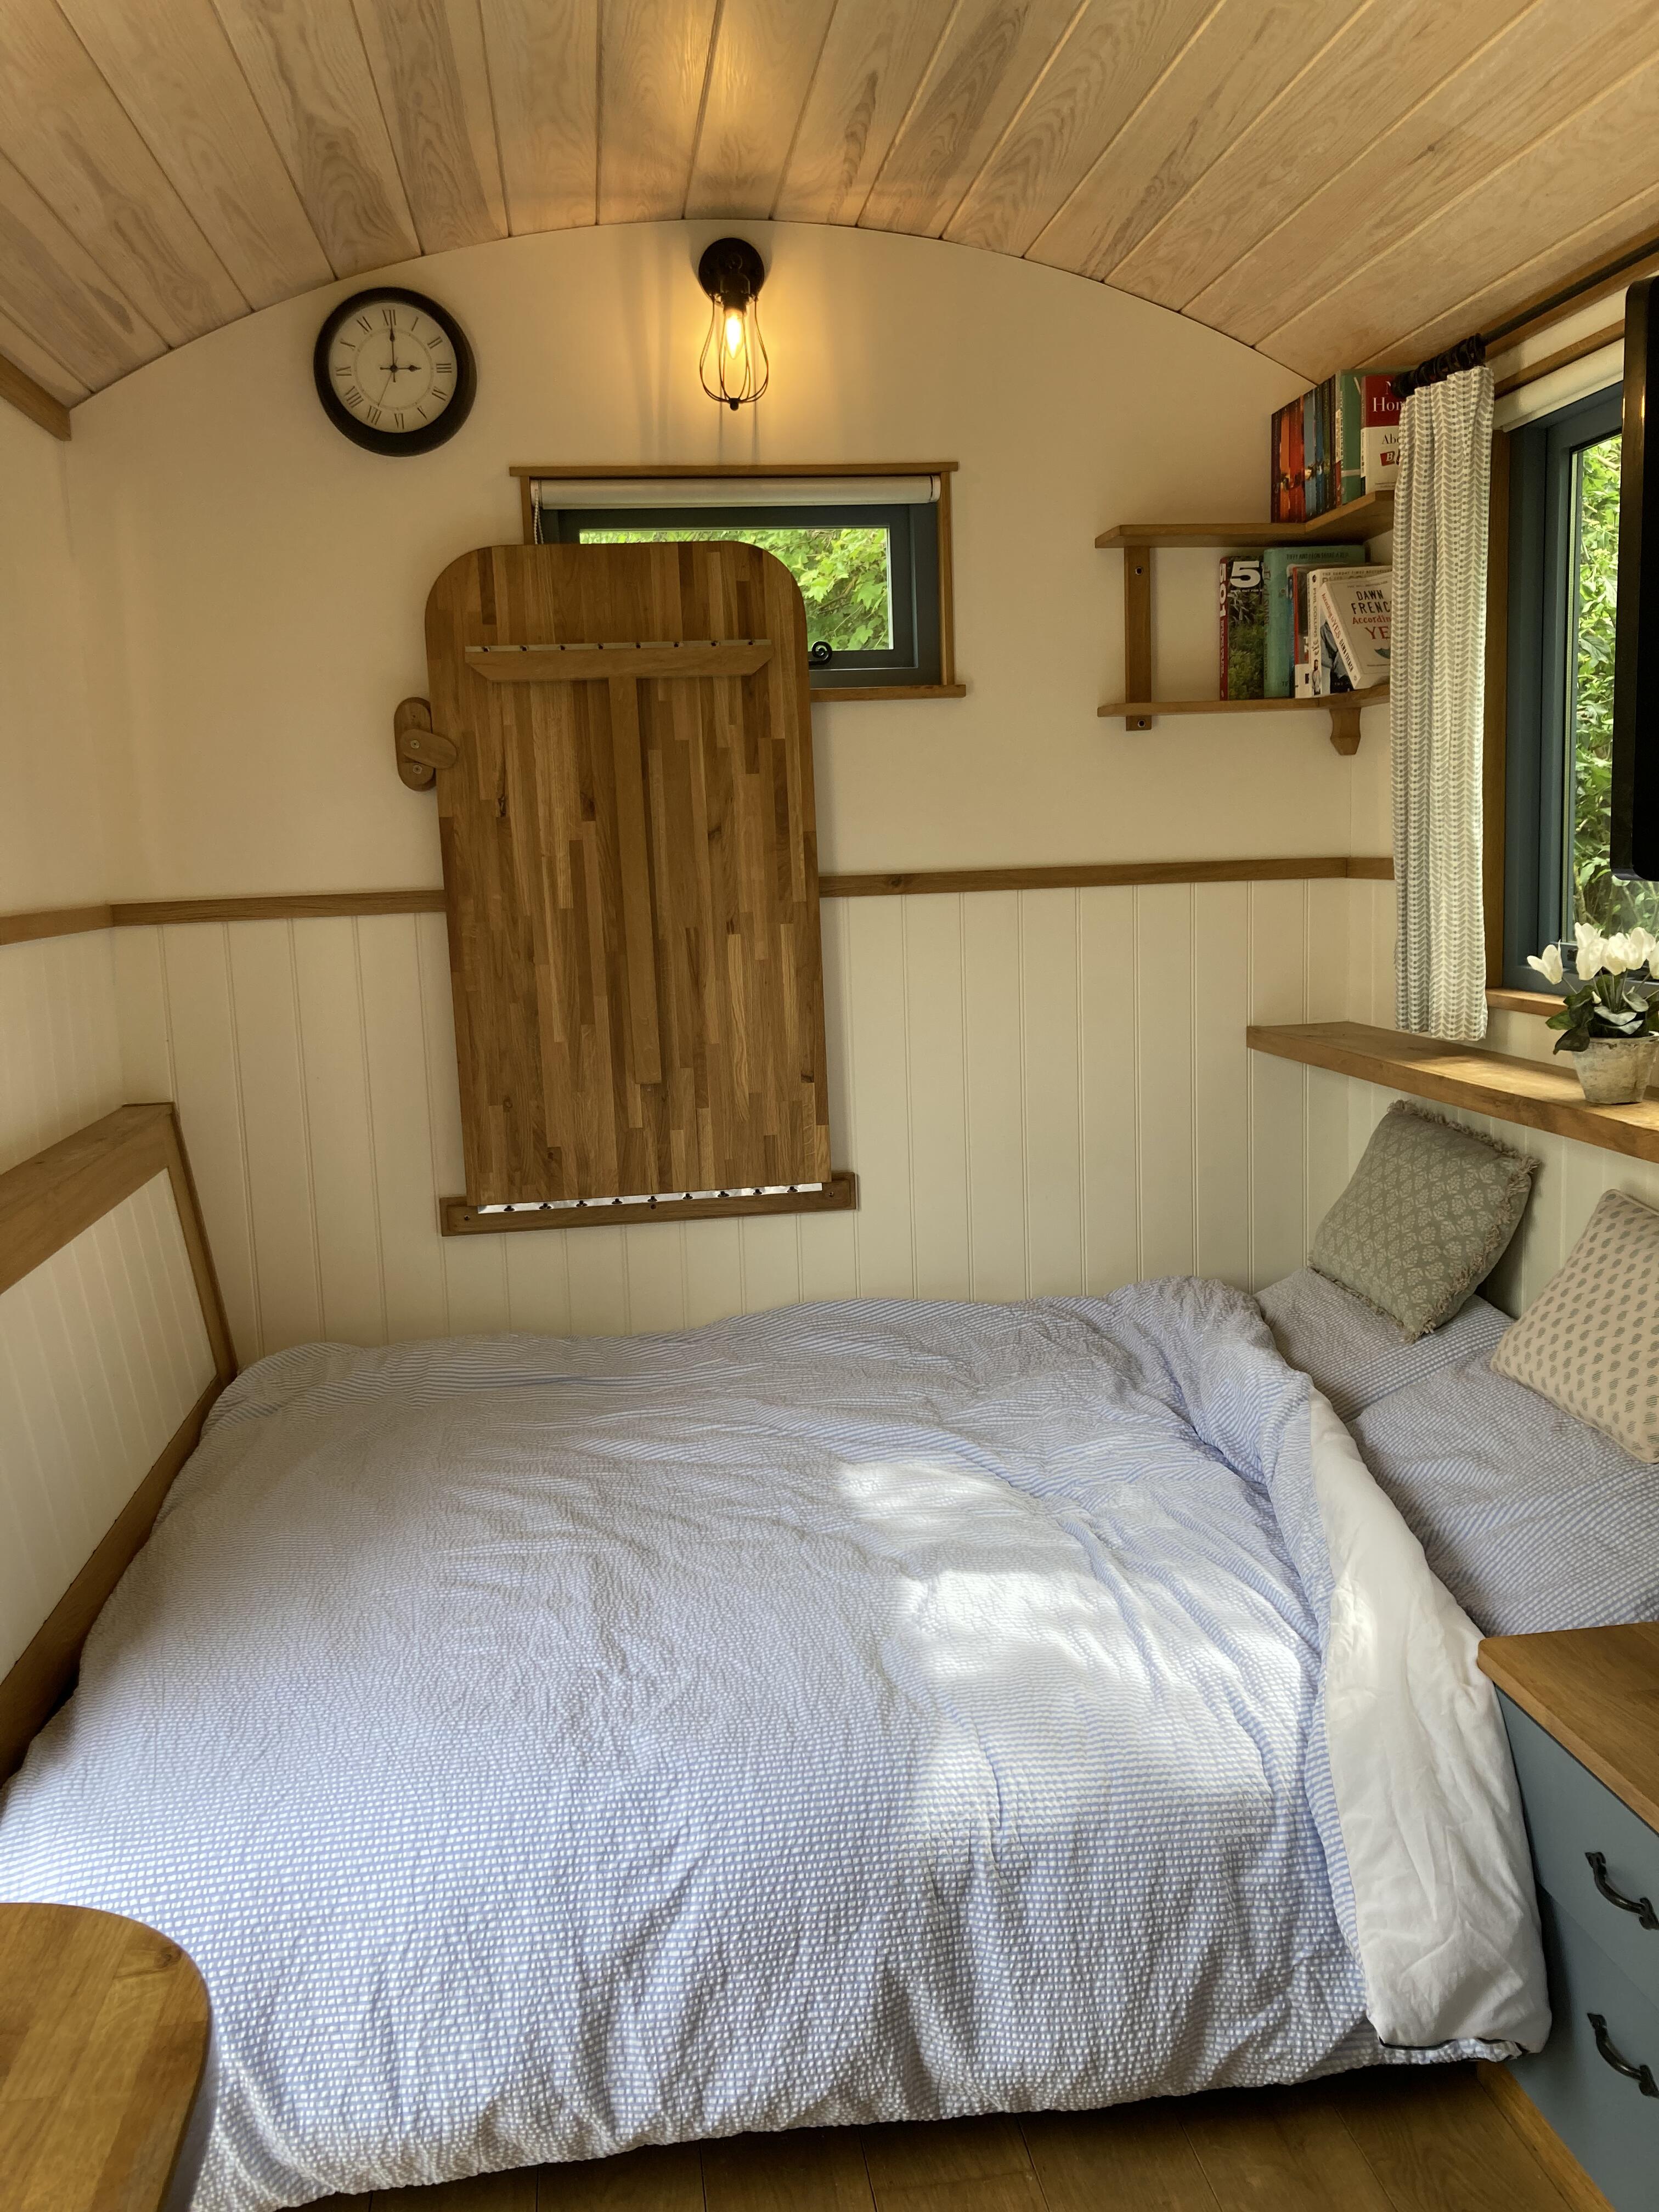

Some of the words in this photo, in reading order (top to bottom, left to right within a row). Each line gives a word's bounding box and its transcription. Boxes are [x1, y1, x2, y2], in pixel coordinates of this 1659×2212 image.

[427, 336, 443, 349] II
[436, 363, 453, 374] III
[1356, 590, 1384, 601] DAWN
[1351, 601, 1392, 614] FRENC
[1364, 627, 1391, 640] YE
